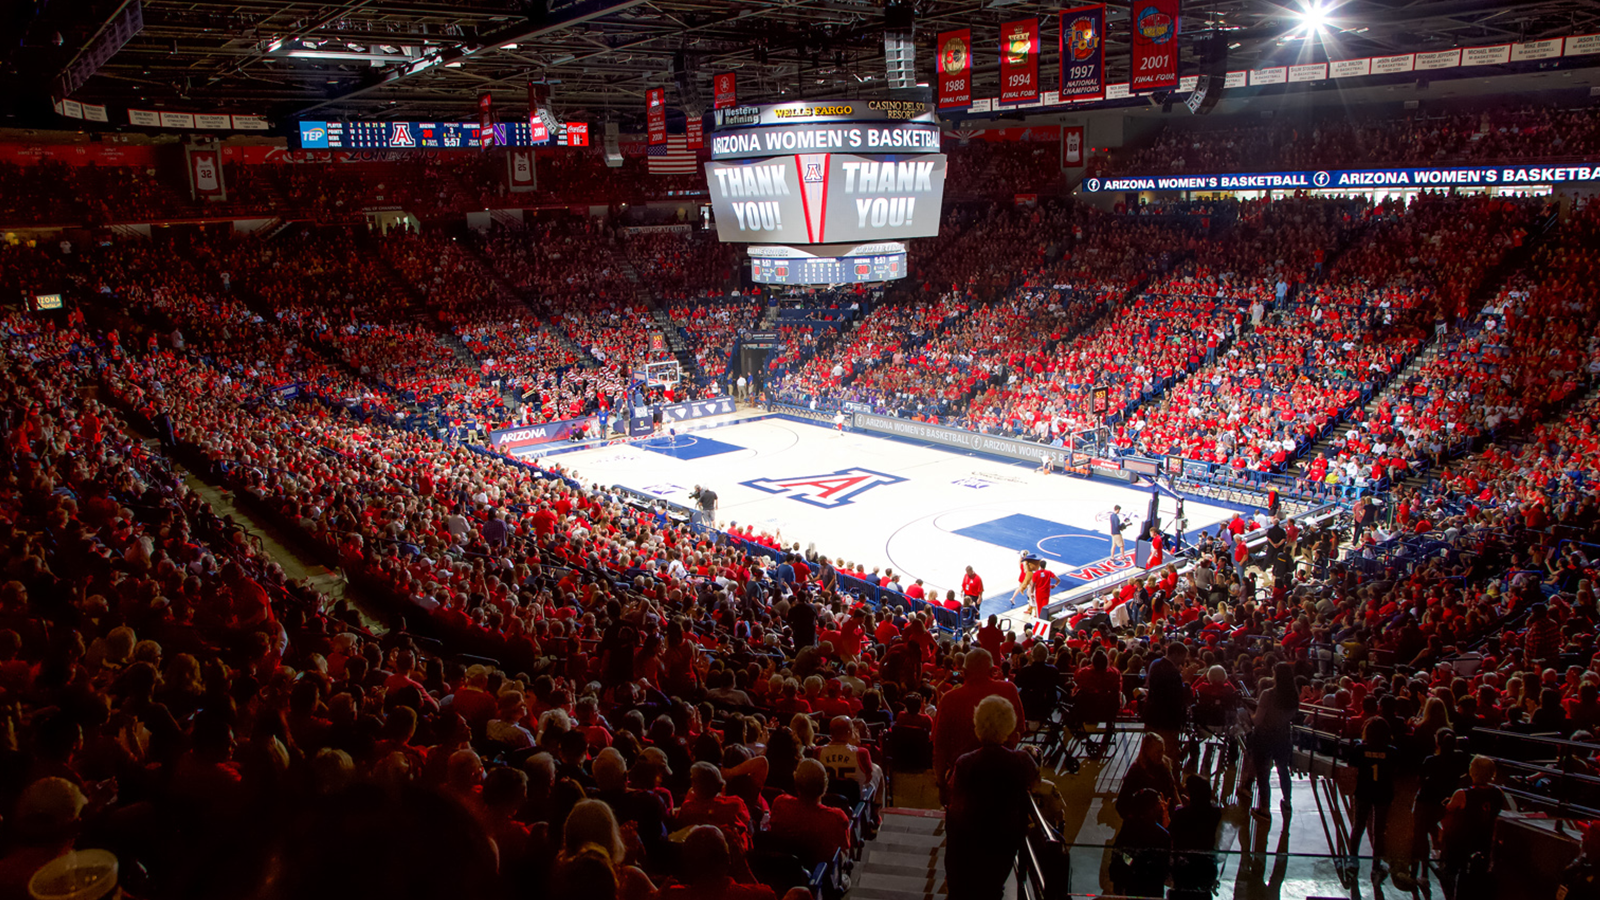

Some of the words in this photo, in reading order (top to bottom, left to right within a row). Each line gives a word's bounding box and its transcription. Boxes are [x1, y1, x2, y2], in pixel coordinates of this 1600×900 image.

[1140, 54, 1169, 70] 2001
[1070, 64, 1095, 80] 1997
[1008, 73, 1031, 87] 1994
[1066, 78, 1098, 88] NATIONAL
[1134, 75, 1154, 84] FINAL
[1155, 73, 1175, 81] FOUR
[945, 78, 966, 92] 1988
[1062, 86, 1100, 96] CHAMPIONS
[940, 96, 954, 104] FINAL
[1002, 91, 1018, 100] FINAL
[725, 106, 759, 117] Western
[773, 108, 813, 118] WELLS
[814, 105, 853, 116] FARGO
[868, 100, 902, 111] CASINO
[903, 102, 914, 111] DEL
[726, 115, 761, 124] Refining
[888, 110, 916, 119] RESORT
[389, 122, 416, 148] A
[422, 129, 434, 138] 30
[472, 129, 480, 138] 17
[494, 122, 507, 146] N
[534, 126, 546, 137] 2001
[568, 124, 588, 134] Coca-Cola
[303, 131, 323, 141] TEP
[713, 132, 762, 155] ARIZONA
[765, 128, 862, 151] WOMEN'S
[868, 128, 940, 148] BASKETBALL
[444, 138, 460, 147] 5:57
[200, 169, 212, 178] 32
[804, 163, 823, 182] A
[1338, 172, 1409, 185] ARIZONA
[1414, 169, 1498, 184] WOMEN'S
[714, 164, 790, 198] THANK
[842, 161, 935, 194] THANK
[1104, 179, 1155, 190] ARIZONA
[1158, 176, 1218, 189] WOMEN'S
[1221, 174, 1308, 188] BASKETBALL
[732, 201, 782, 232] YOU!
[855, 197, 916, 229] YOU!
[498, 428, 547, 444] ARIZONA
[866, 419, 892, 431] ARIZONA
[894, 422, 925, 436] WOMEN'S
[926, 428, 970, 446] BASKETBALL
[984, 441, 1018, 455] ARIZONA
[1018, 446, 1058, 463] WOMEN'S
[737, 466, 911, 509] A
[825, 754, 850, 764] KERR
